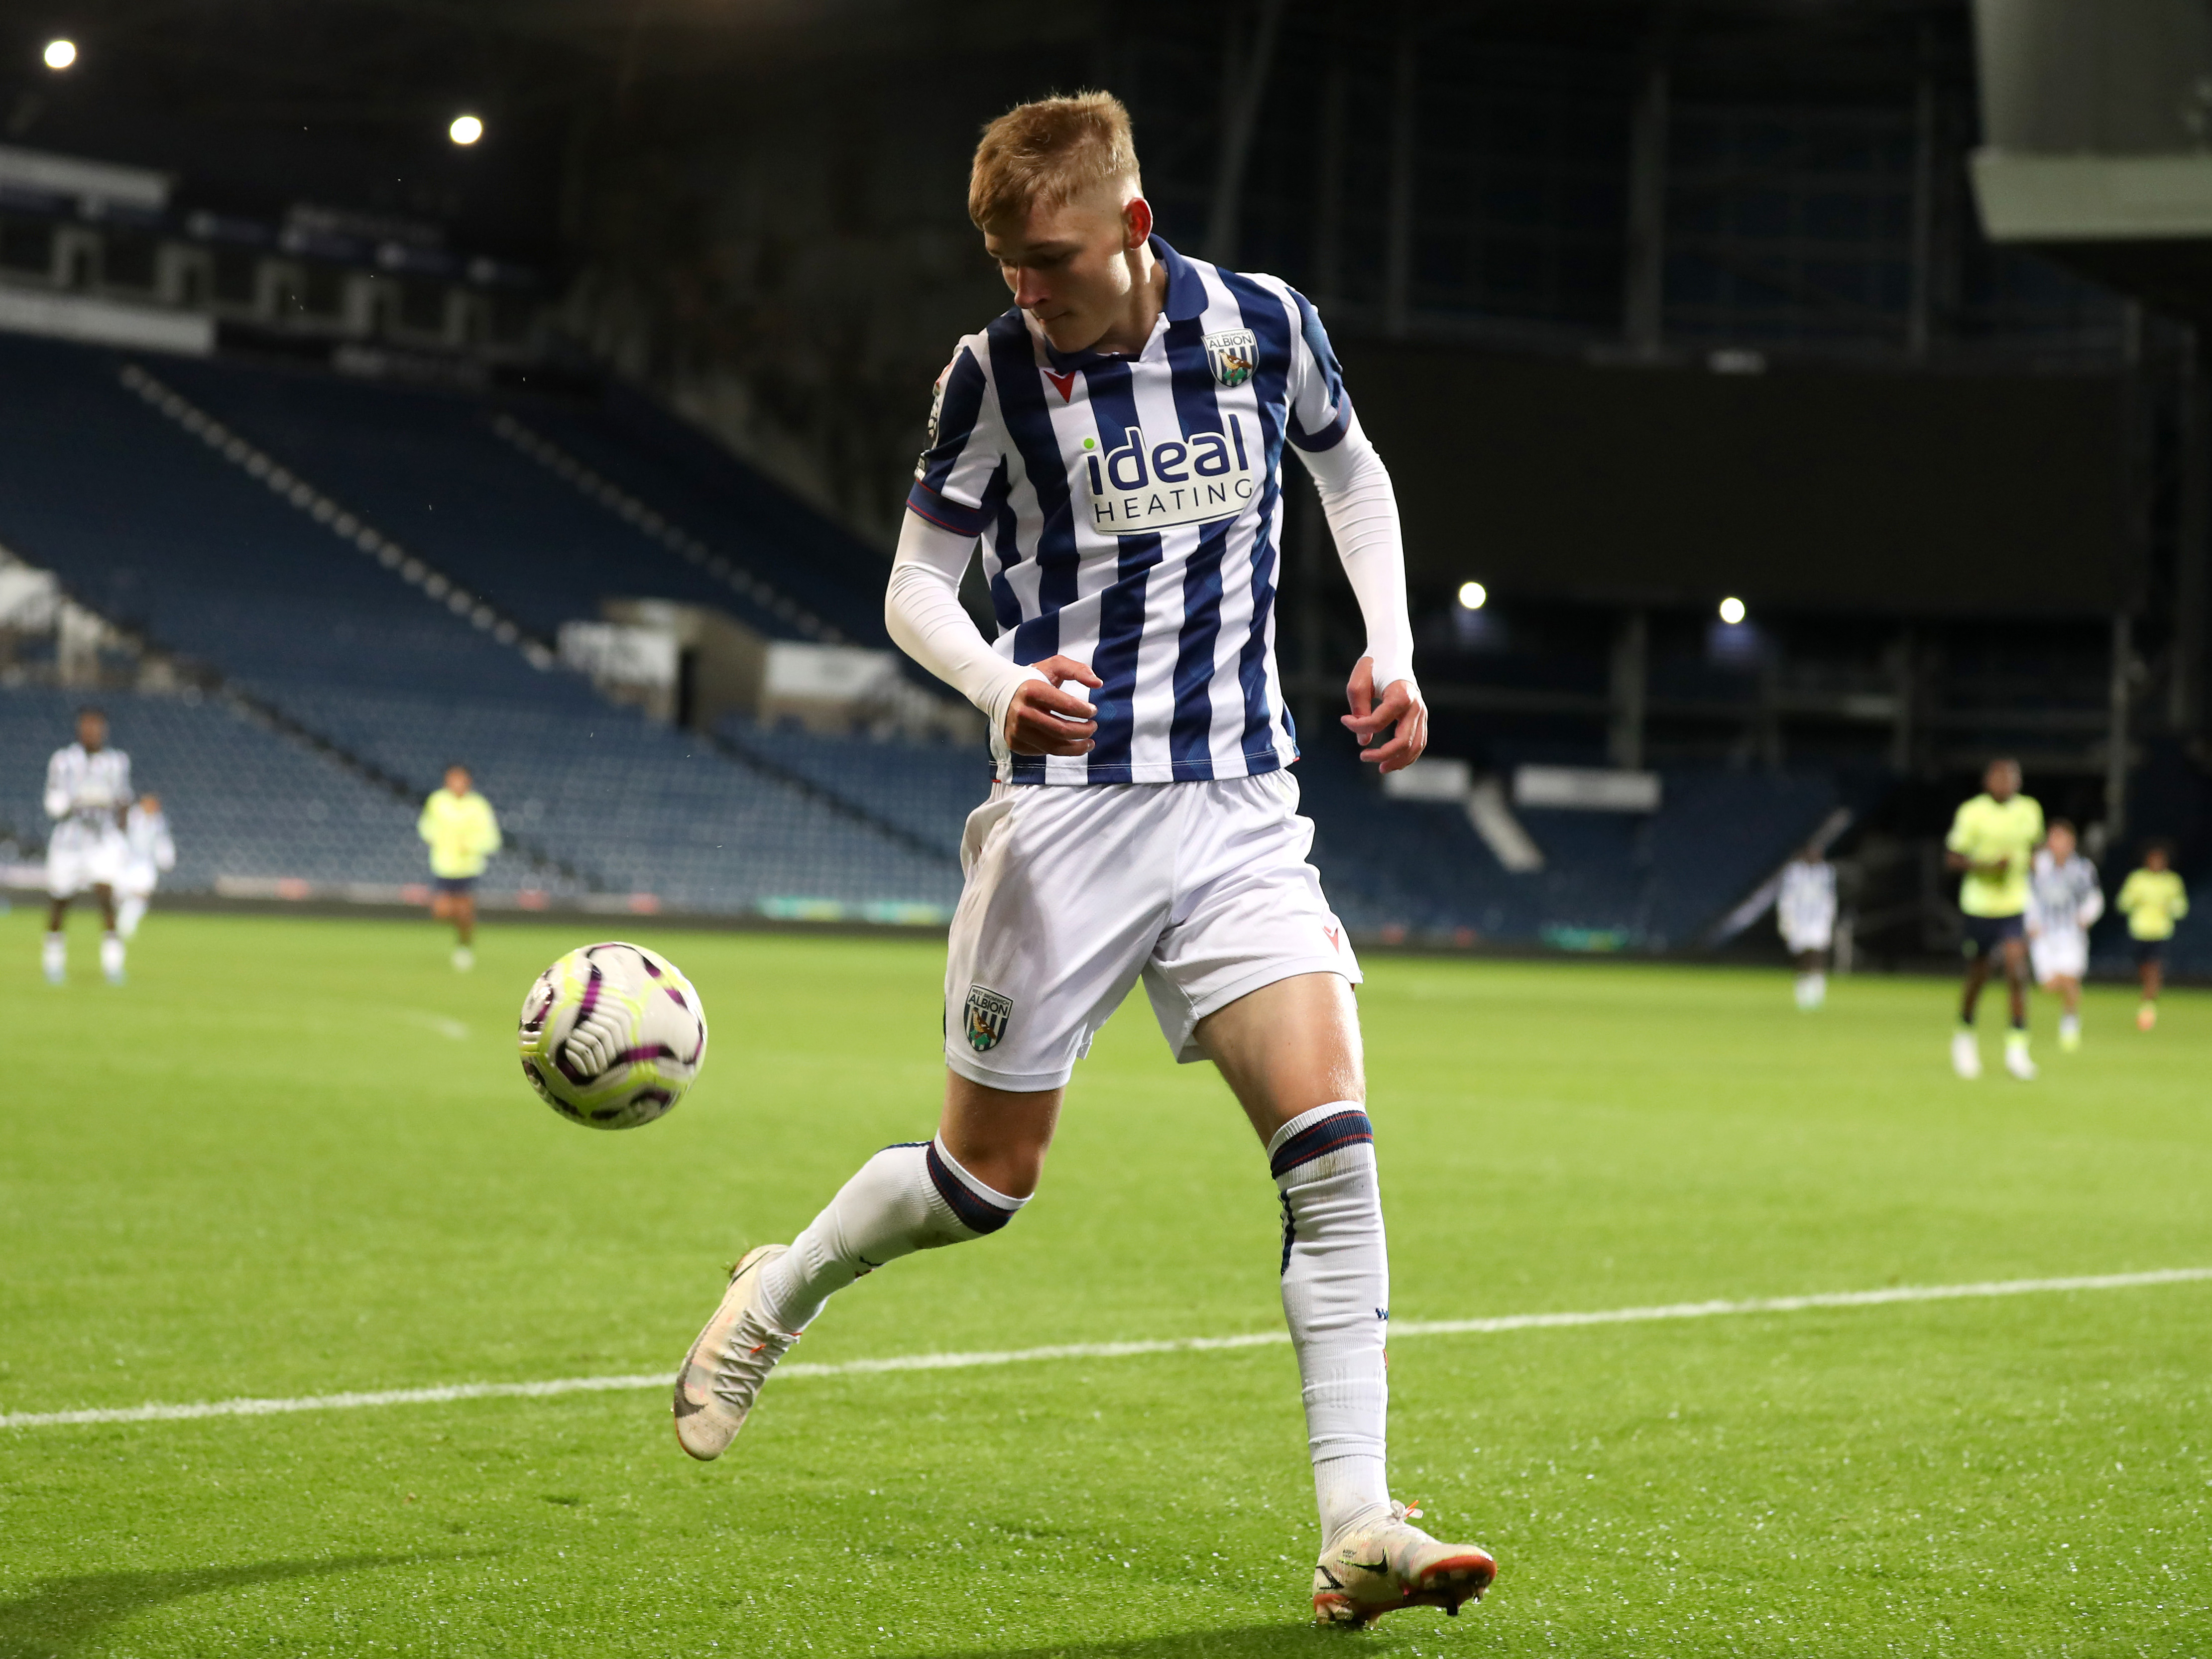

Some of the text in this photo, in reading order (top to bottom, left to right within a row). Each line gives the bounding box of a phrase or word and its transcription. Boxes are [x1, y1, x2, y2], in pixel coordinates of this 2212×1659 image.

[1210, 335, 1252, 348] ALBION
[1083, 414, 1249, 495] ideal
[1095, 478, 1252, 523] HEATING
[968, 994, 1008, 1016] ALBION
